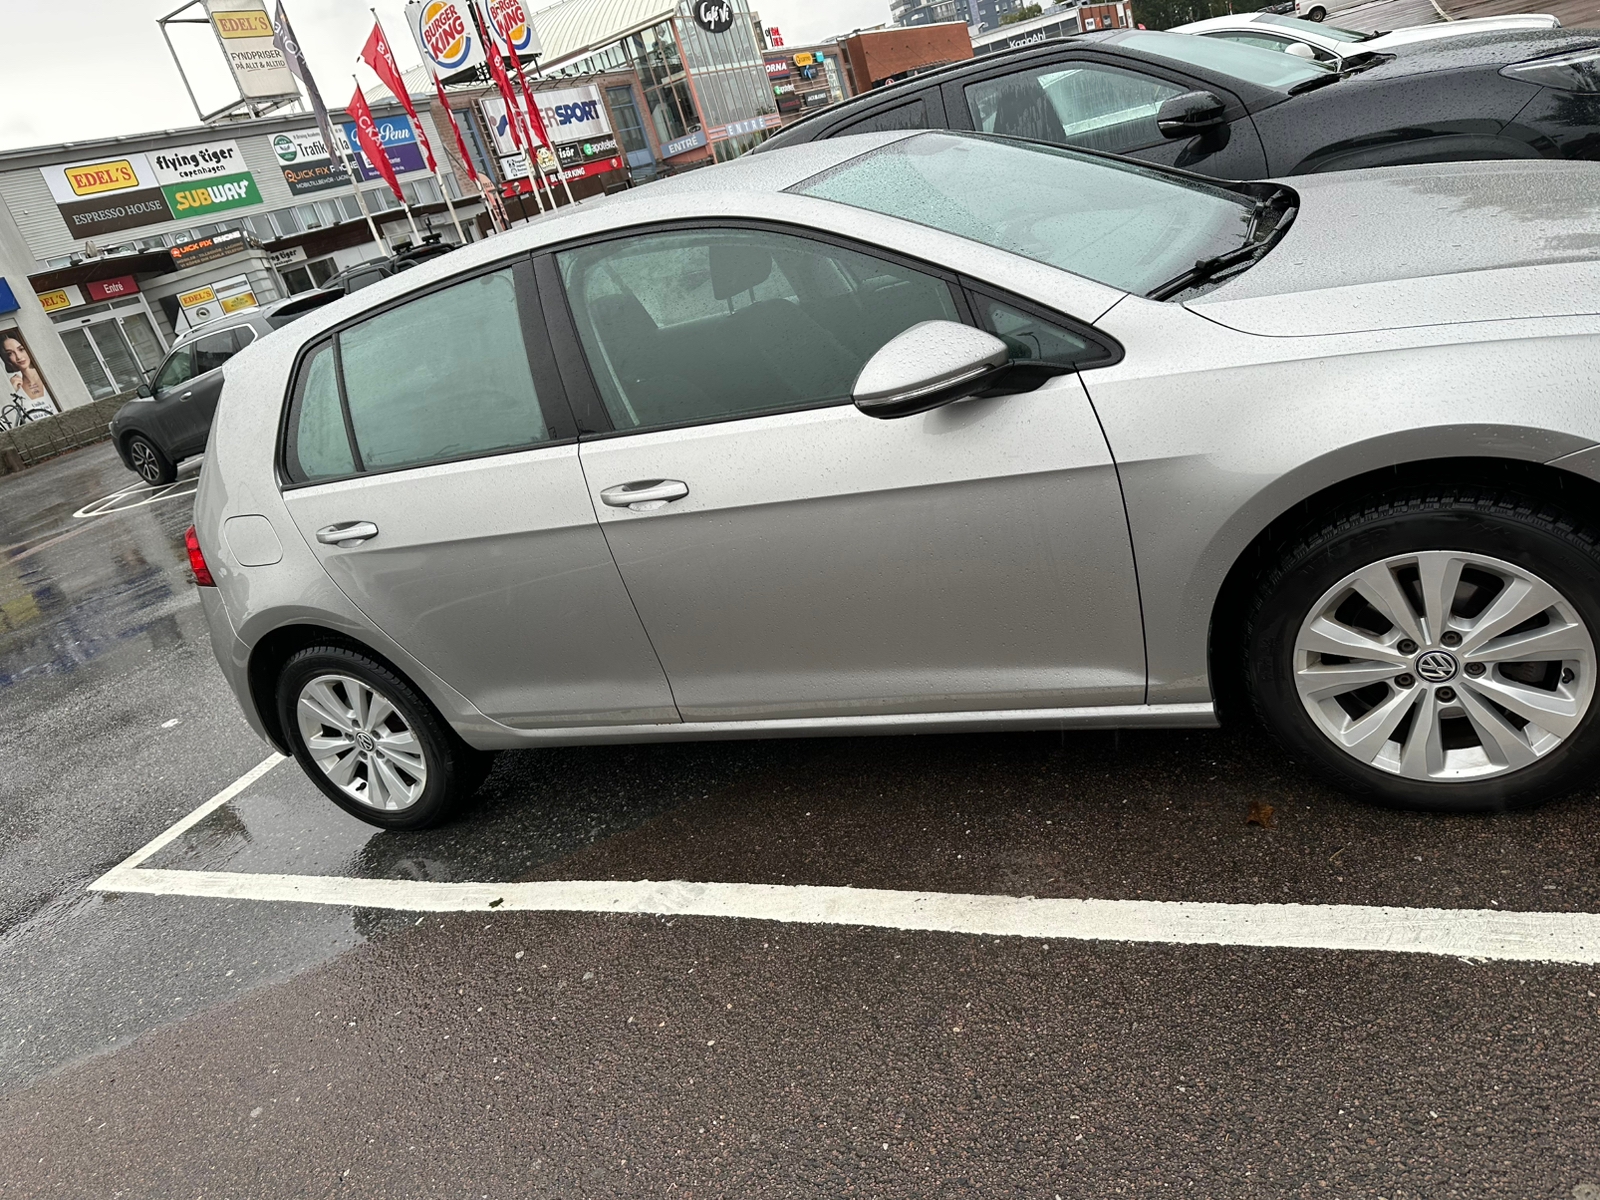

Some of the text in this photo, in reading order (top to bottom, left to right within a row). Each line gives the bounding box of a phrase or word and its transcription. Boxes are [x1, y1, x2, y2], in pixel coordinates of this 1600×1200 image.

[424, 4, 458, 44] BURGER
[700, 1, 730, 29] Café Vi
[430, 15, 465, 60] KING
[230, 49, 282, 61] FYNDPRISER
[235, 61, 245, 71] PÅ
[245, 62, 259, 70] ALLT
[266, 60, 286, 68] ALLTID
[379, 123, 410, 142] Penn
[559, 147, 575, 158] isör
[669, 136, 699, 154] ENTRÉ
[156, 148, 234, 171] flying tiger
[72, 167, 132, 188] EDEL'S
[179, 165, 226, 178] copenhagen
[284, 169, 315, 183] QUICK
[315, 166, 330, 175] FIX
[175, 179, 249, 211] SUBWAY
[72, 200, 163, 225] ESPRESSO HOUSE
[103, 281, 124, 294] Entré
[41, 294, 66, 308] DEL'S
[182, 290, 212, 304] EDEL'S
